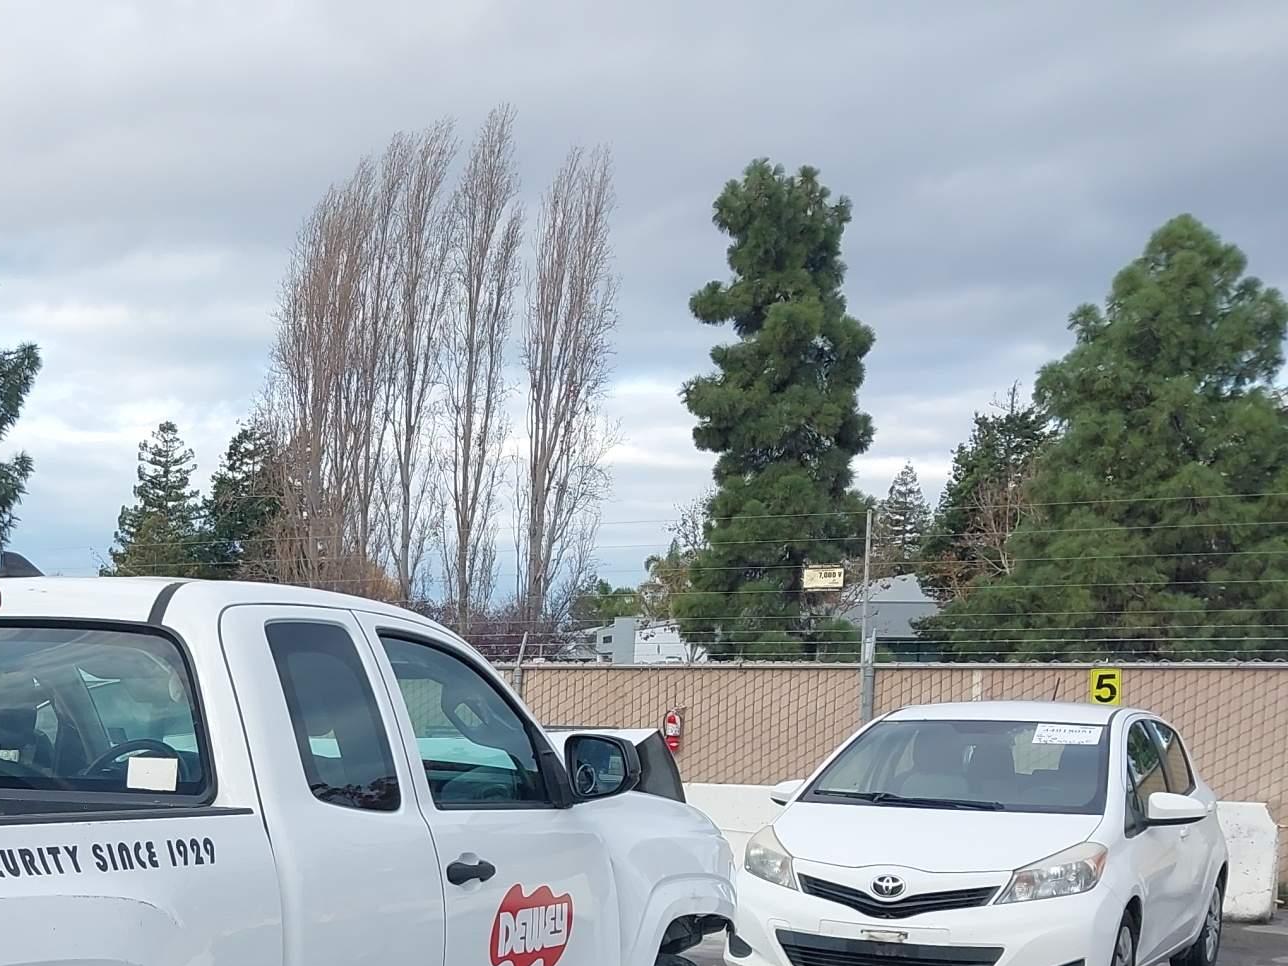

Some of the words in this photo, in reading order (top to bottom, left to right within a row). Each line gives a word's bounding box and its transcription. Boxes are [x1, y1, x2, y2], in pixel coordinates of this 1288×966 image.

[1095, 674, 1117, 703] 5
[92, 841, 160, 872] SINCE
[167, 838, 216, 867] 1929
[497, 903, 569, 958] DEWEY
